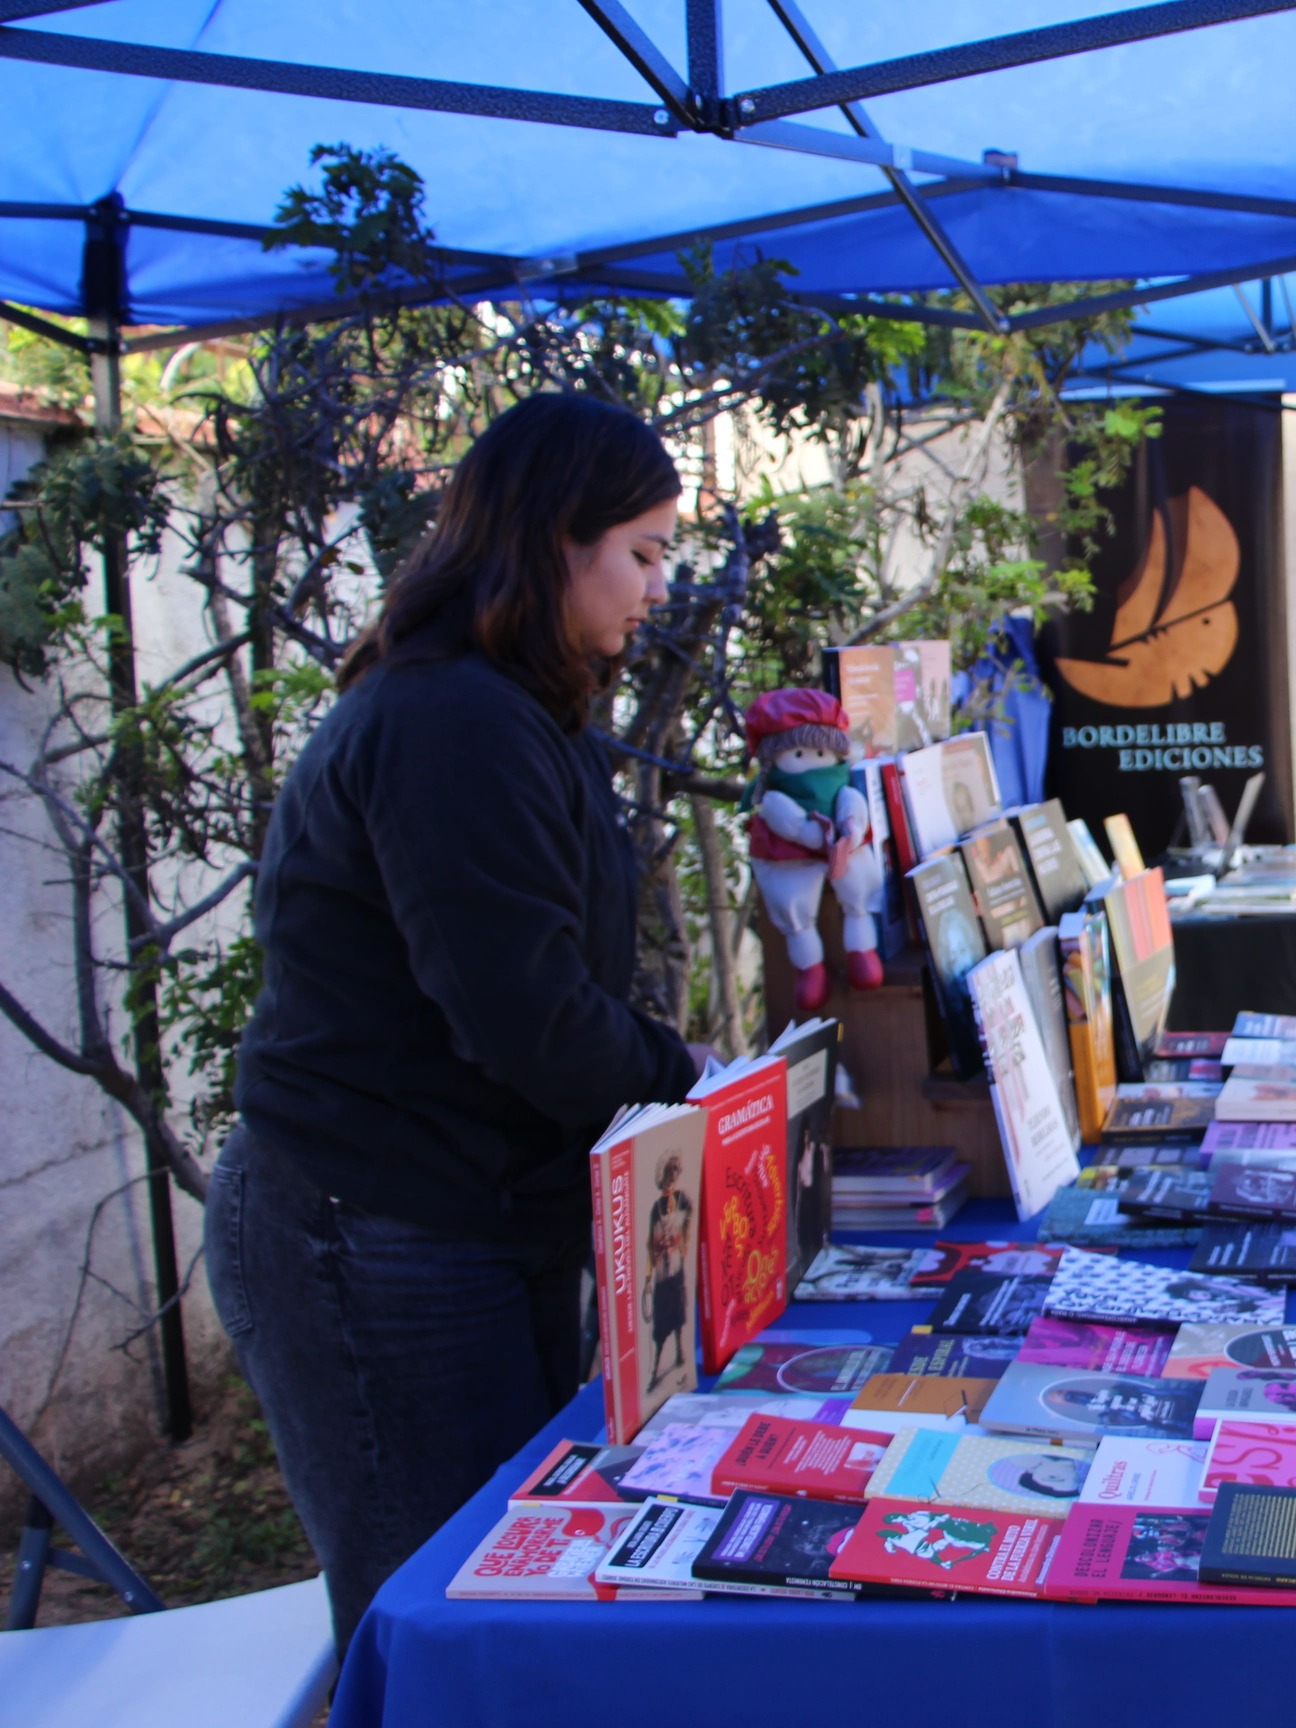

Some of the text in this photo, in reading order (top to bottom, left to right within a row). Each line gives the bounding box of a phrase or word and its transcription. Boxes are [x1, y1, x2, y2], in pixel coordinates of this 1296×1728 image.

[1063, 721, 1226, 748] BORDELIBRE
[1119, 745, 1264, 771] EDICIONES
[718, 1094, 775, 1136] GRAMÁTICA
[611, 1174, 627, 1295] UKUKUS
[749, 1437, 760, 1446] LE
[753, 1421, 771, 1438] DEBE
[1098, 1460, 1127, 1499] Quiltras
[1021, 1518, 1039, 1537] VIRIL
[473, 1516, 542, 1576] QUE LOCURA
[502, 1517, 564, 1576] ENAMORARME
[534, 1549, 563, 1562] DE
[986, 1525, 1021, 1580] CONTRA EL MITO
[1010, 1537, 1032, 1562] FUERZA
[1074, 1519, 1104, 1578] DESCOLONIZAR
[1001, 1571, 1017, 1582] DE
[1006, 1562, 1021, 1572] LA
[1091, 1568, 1107, 1578] EL
[786, 1577, 811, 1586] FEMINISTA
[812, 1579, 848, 1589] CONSTELACIÓN
